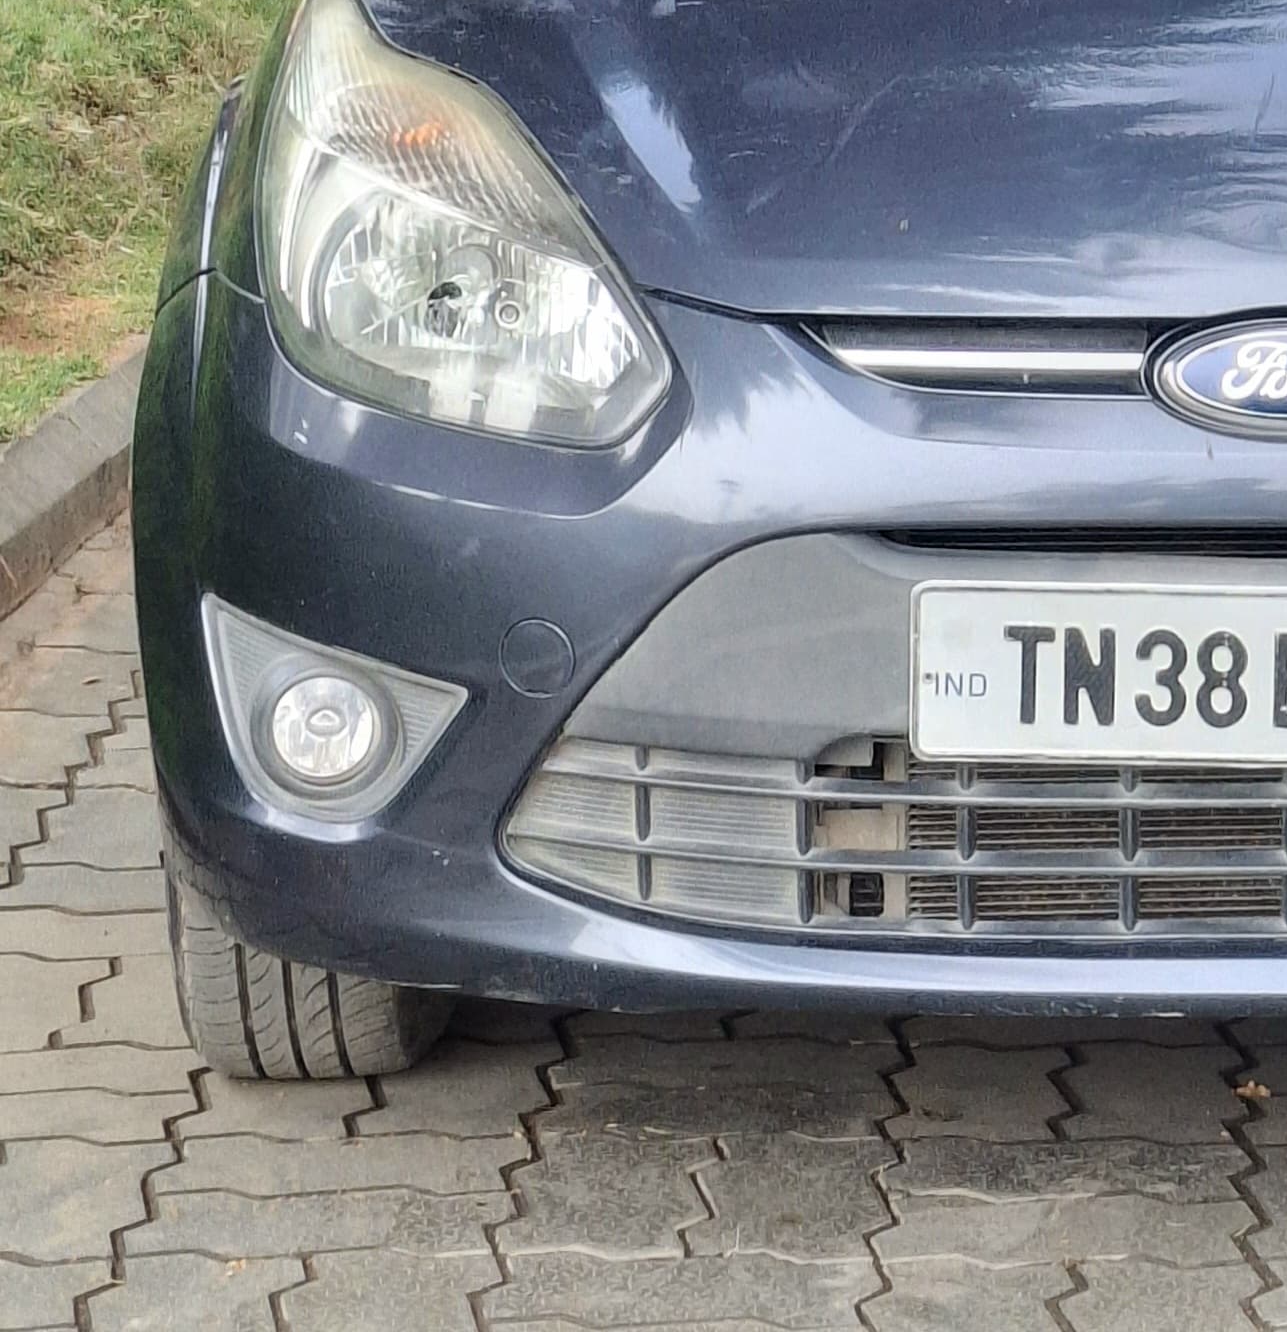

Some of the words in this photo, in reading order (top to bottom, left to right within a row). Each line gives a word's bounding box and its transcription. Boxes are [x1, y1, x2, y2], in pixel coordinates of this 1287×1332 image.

[934, 671, 988, 698] IND
[1003, 625, 1116, 726] TN
[1135, 630, 1248, 728] 38
